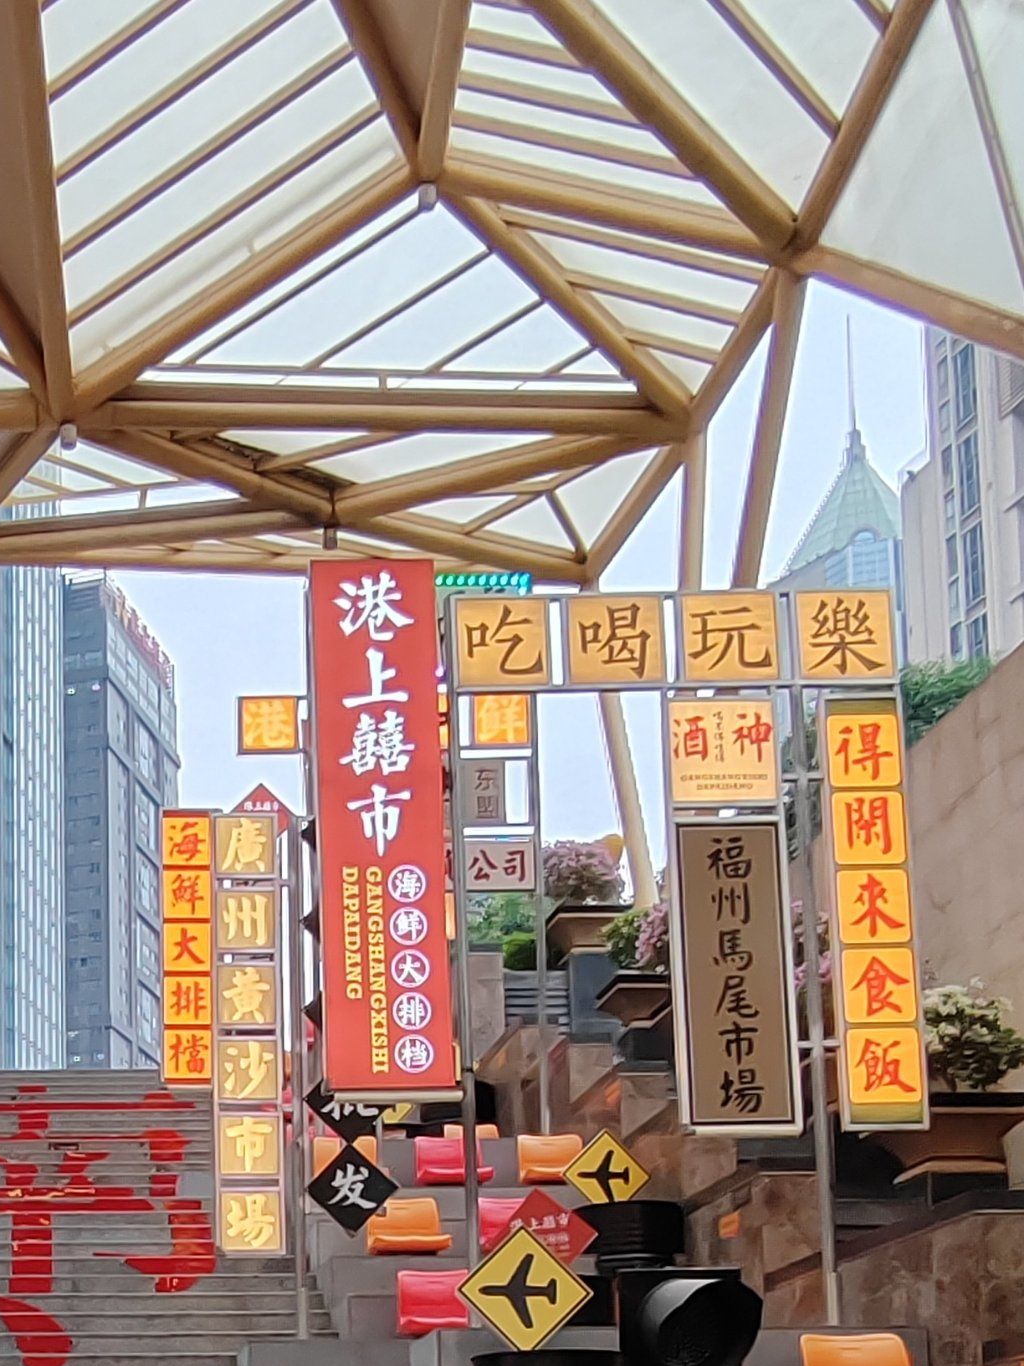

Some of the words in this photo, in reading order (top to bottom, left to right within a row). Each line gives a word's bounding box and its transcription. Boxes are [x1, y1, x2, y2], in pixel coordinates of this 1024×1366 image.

[463, 596, 886, 678] 吃喝玩樂
[331, 569, 416, 858] 港上囍市
[672, 712, 774, 763] 酒神
[468, 849, 527, 882] 公司
[342, 866, 363, 1000] DAPAIDANG
[365, 866, 390, 1073] GANGSHANGXISHI
[706, 837, 765, 1114] 福州馬尾市場
